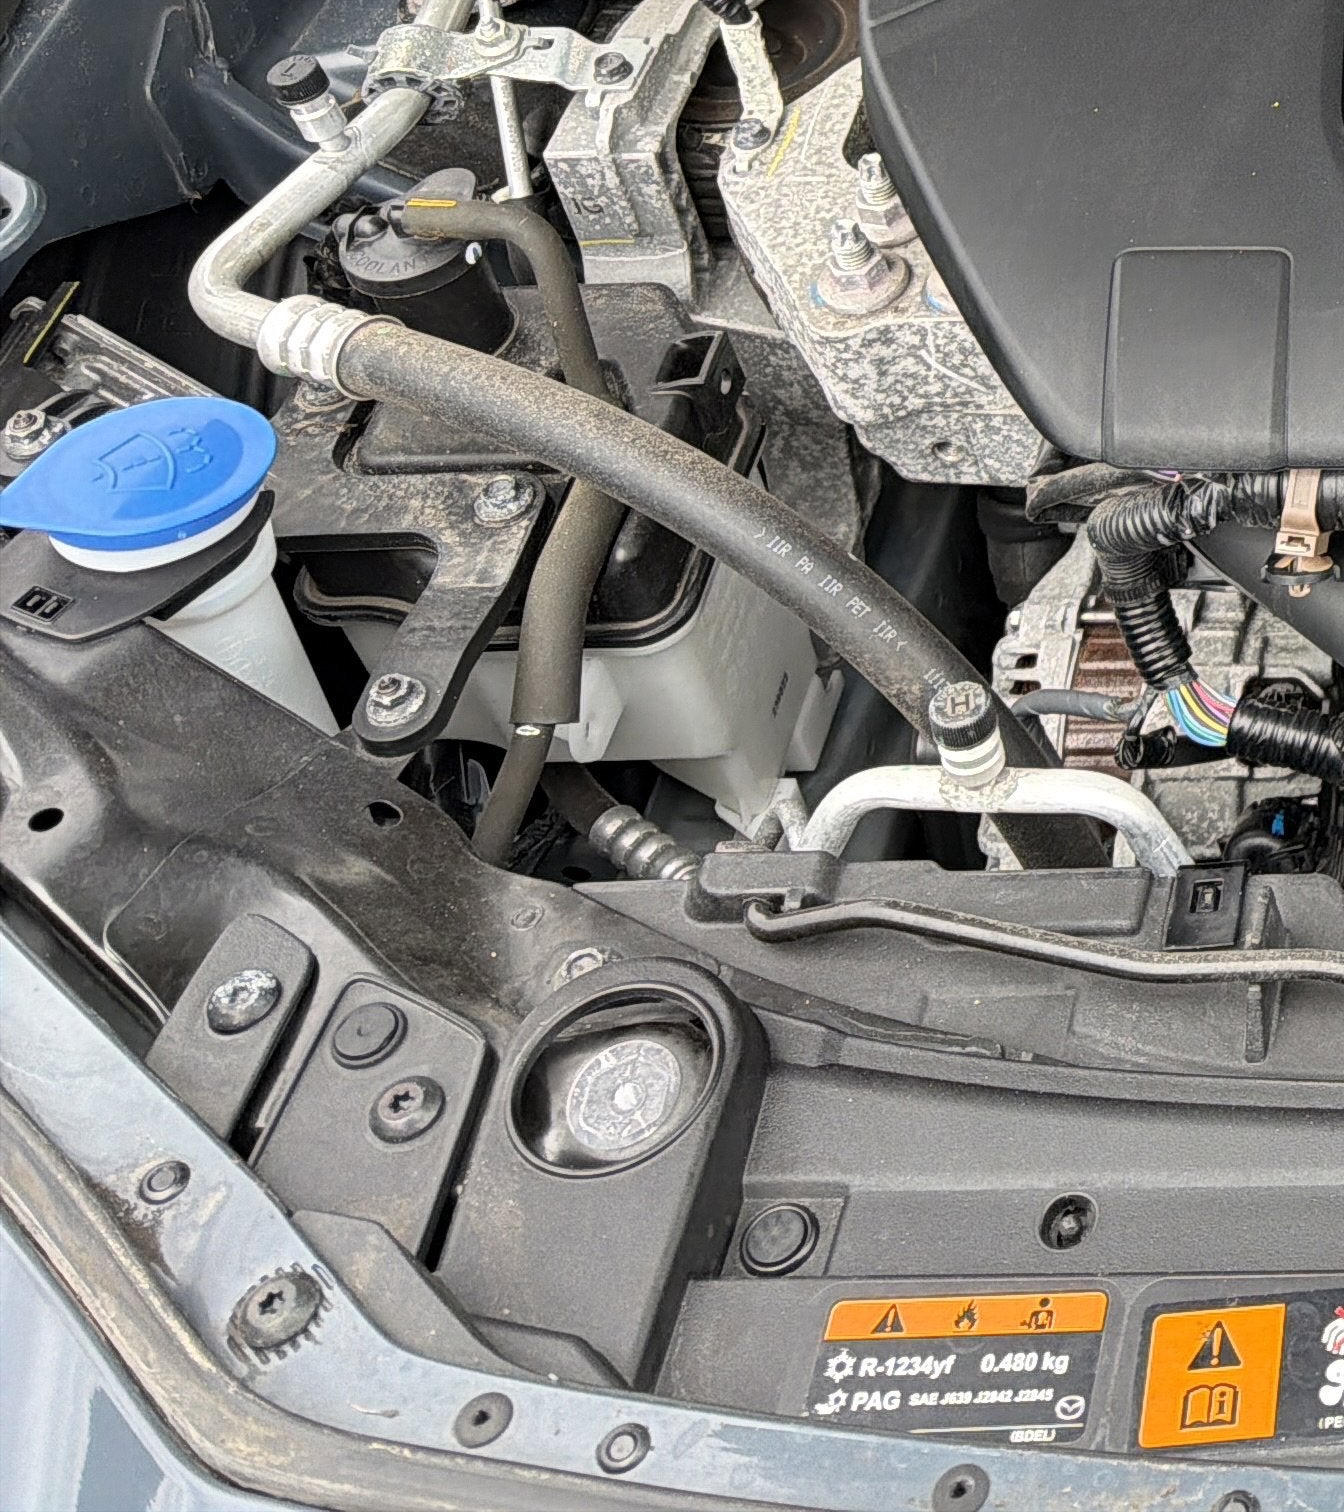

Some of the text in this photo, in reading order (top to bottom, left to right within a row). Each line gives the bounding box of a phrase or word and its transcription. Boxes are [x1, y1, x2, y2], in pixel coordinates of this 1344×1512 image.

[794, 555, 814, 575] PA
[818, 574, 843, 597] IIR
[845, 595, 872, 619] PET
[858, 1351, 1070, 1379] R-1234yf 0.480 kg
[850, 1390, 902, 1411] PAG
[907, 1391, 940, 1406] SAE
[940, 1391, 972, 1405] J639
